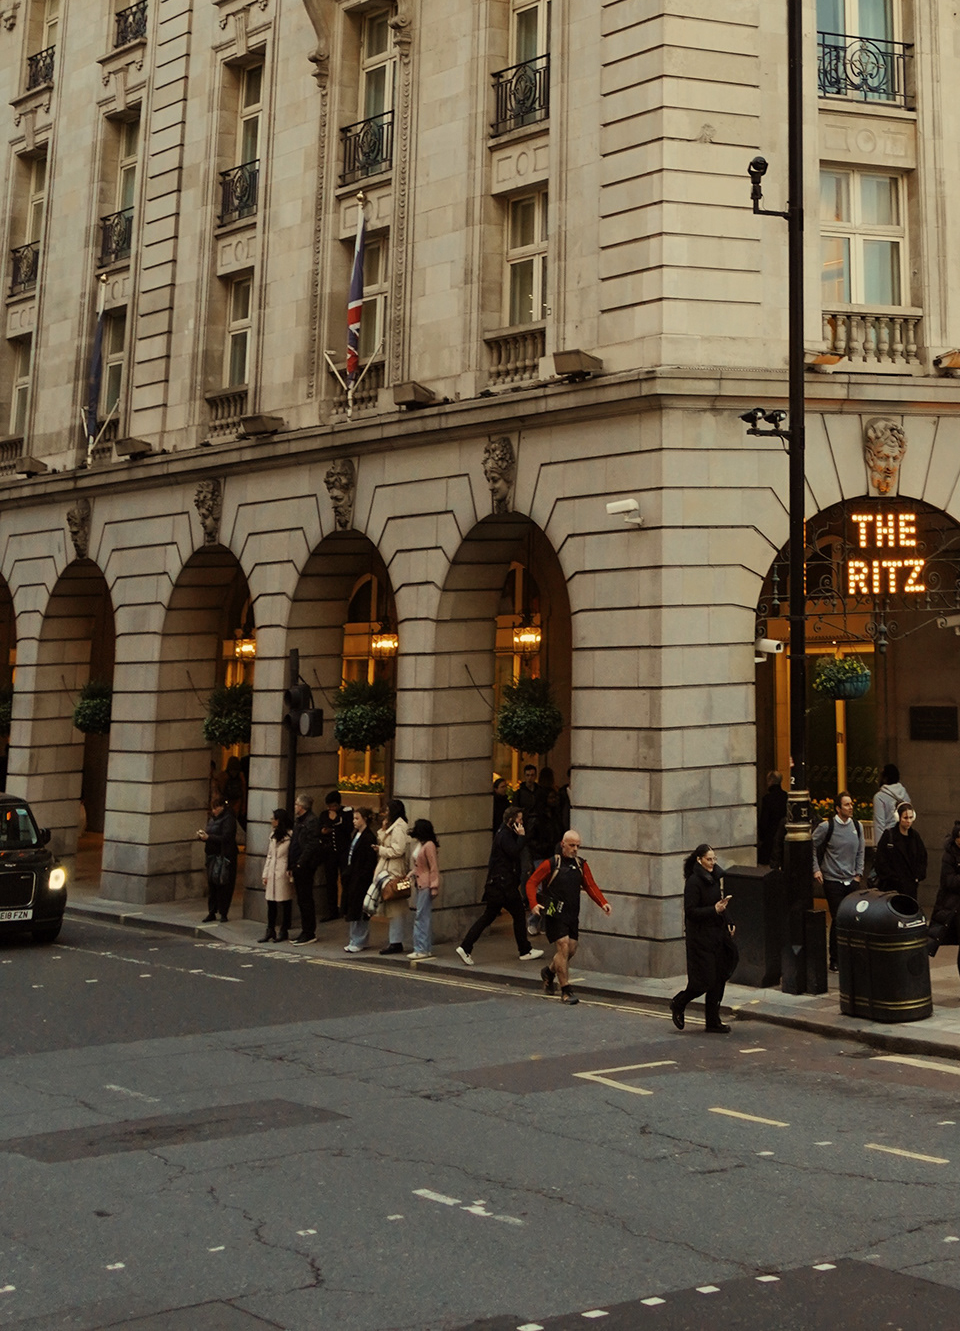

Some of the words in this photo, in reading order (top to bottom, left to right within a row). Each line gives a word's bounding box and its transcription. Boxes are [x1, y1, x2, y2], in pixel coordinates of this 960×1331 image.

[851, 513, 917, 548] THE
[848, 559, 925, 594] RITZ
[13, 911, 28, 919] FZN
